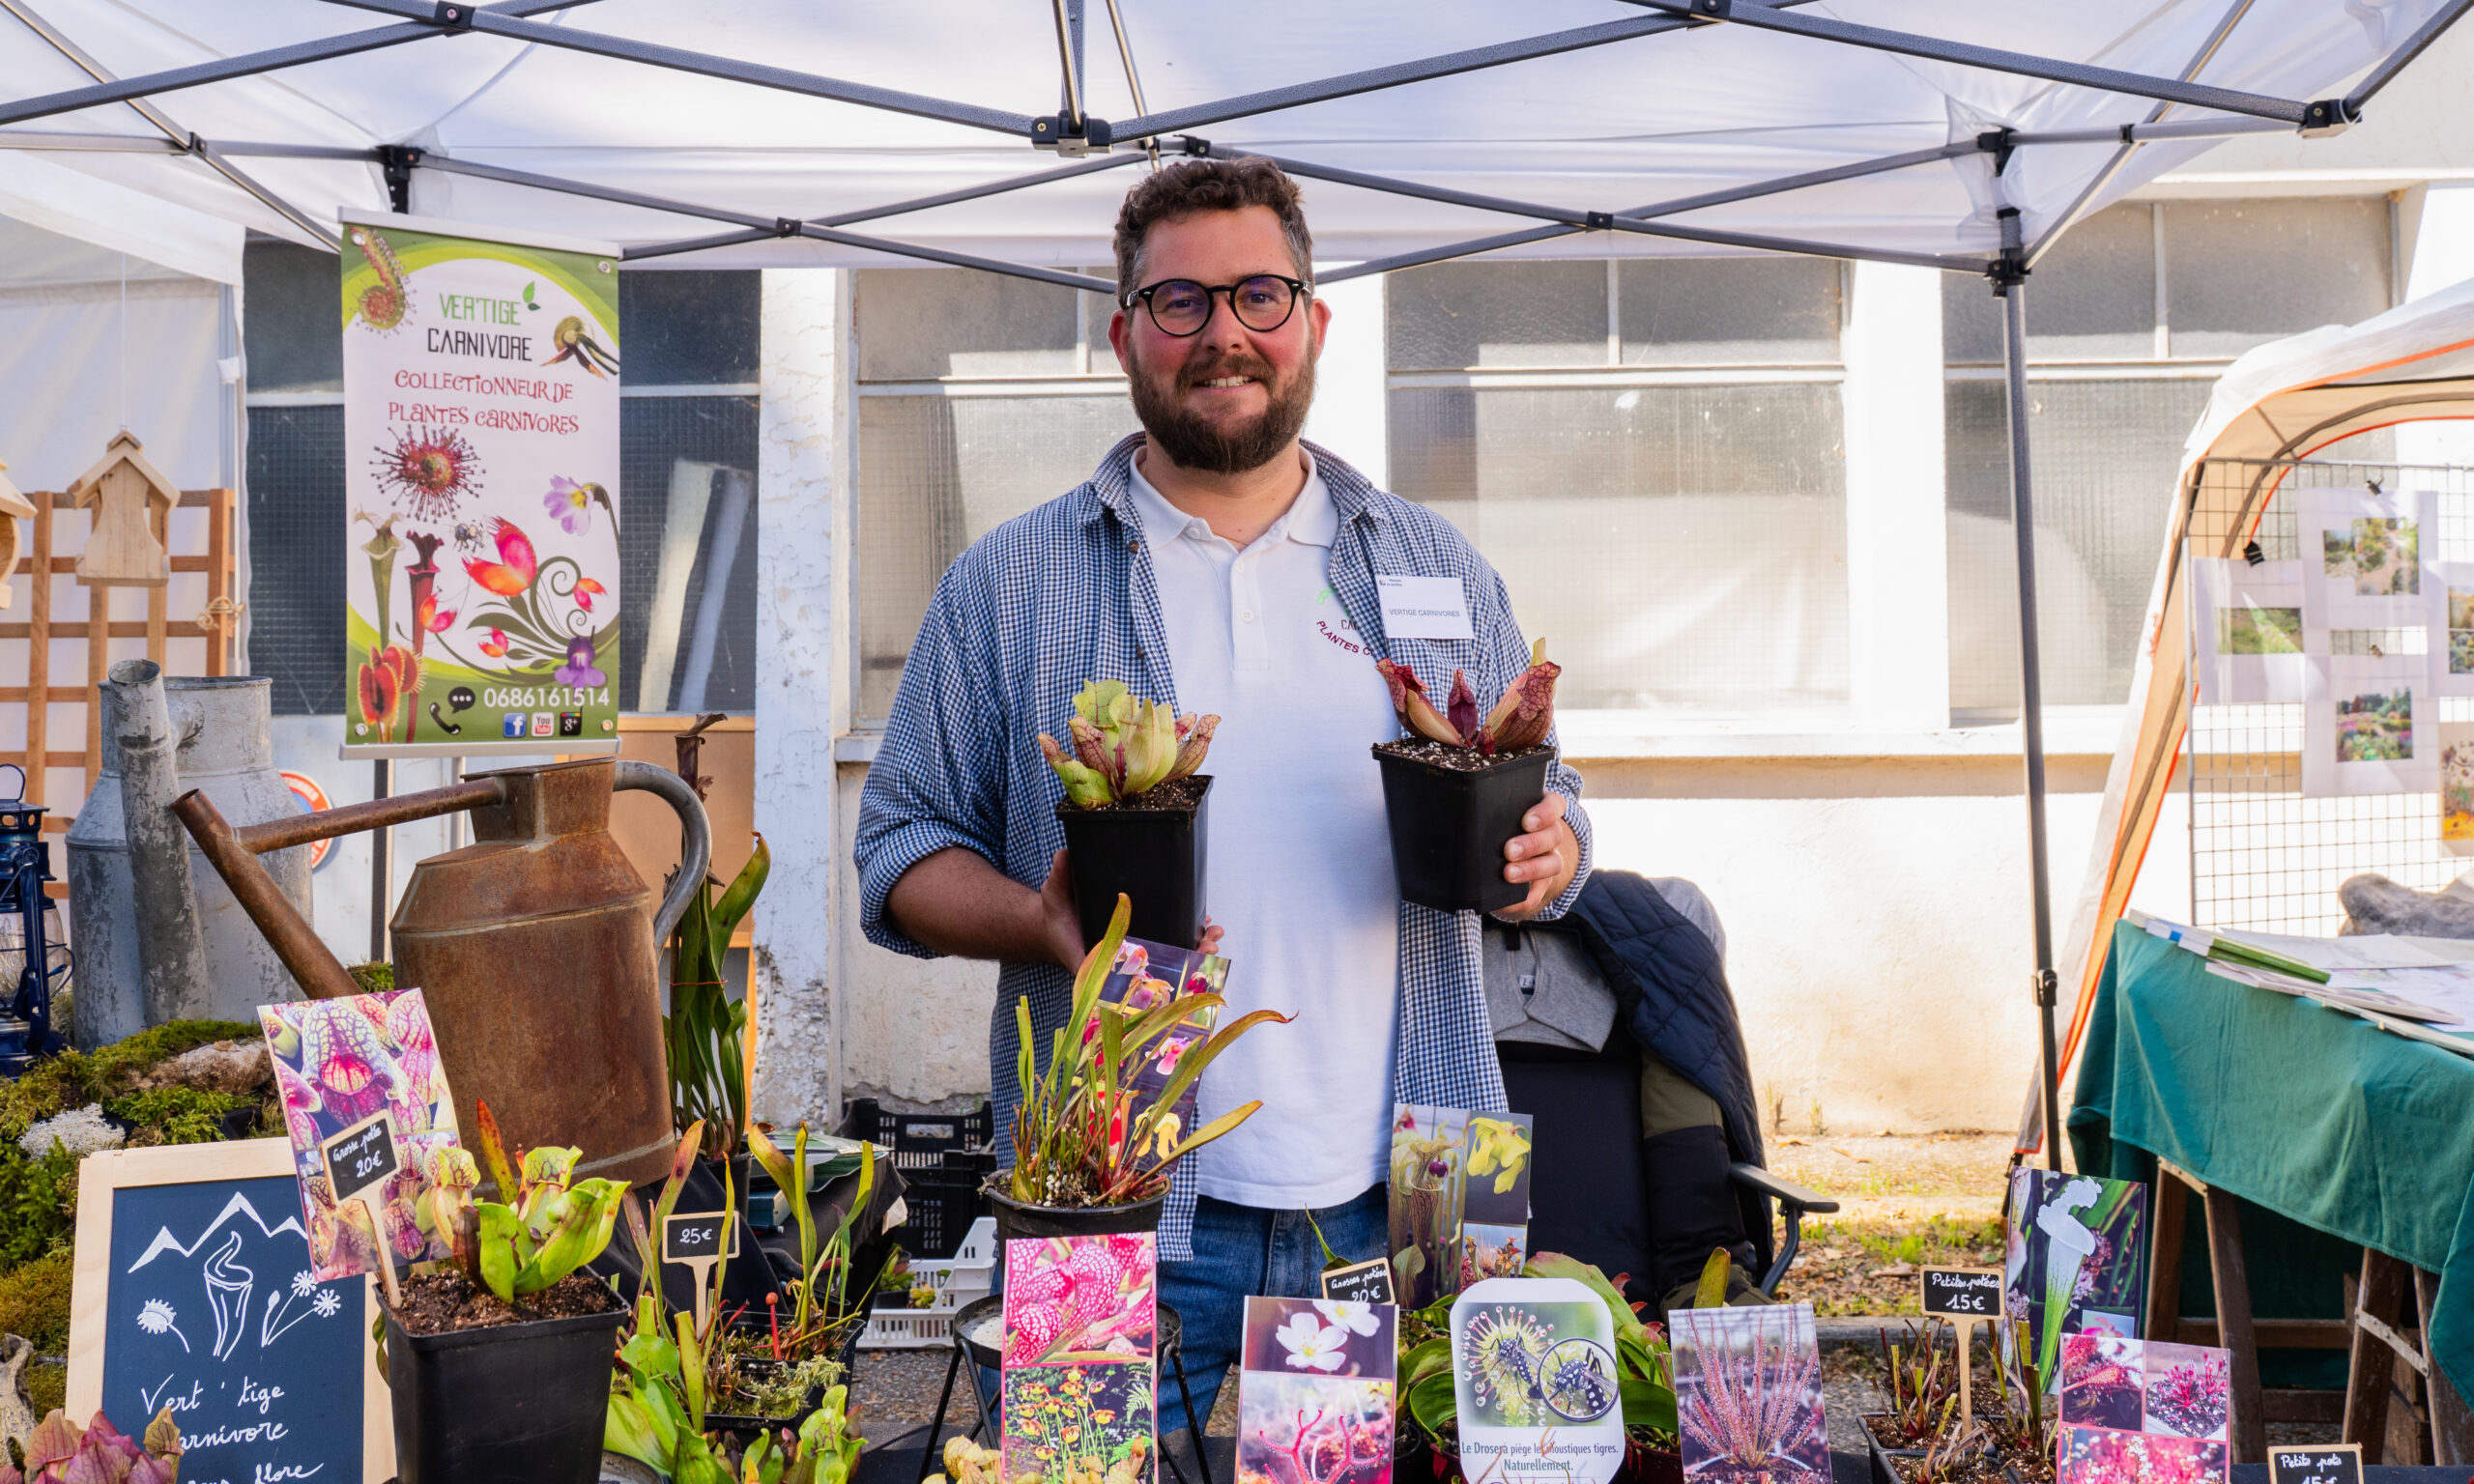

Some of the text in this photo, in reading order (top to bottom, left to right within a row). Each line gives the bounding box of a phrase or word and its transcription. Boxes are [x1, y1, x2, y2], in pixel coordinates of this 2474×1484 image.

[428, 328, 532, 361] CARNIVORE
[551, 383, 573, 403] DE
[1316, 620, 1360, 653] PLANTES
[483, 687, 610, 708] 0686161514
[356, 1150, 383, 1178] 20€
[679, 1227, 712, 1244] 25€
[1945, 1294, 1986, 1310] 15€
[180, 1421, 289, 1450] arnivore
[1461, 1441, 1472, 1454] Le
[1510, 1443, 1532, 1456] piège
[1534, 1443, 1544, 1454] le
[1594, 1443, 1619, 1456] tigres.
[1504, 1458, 1574, 1471] Naturellement.
[2316, 1453, 2343, 1473] pots
